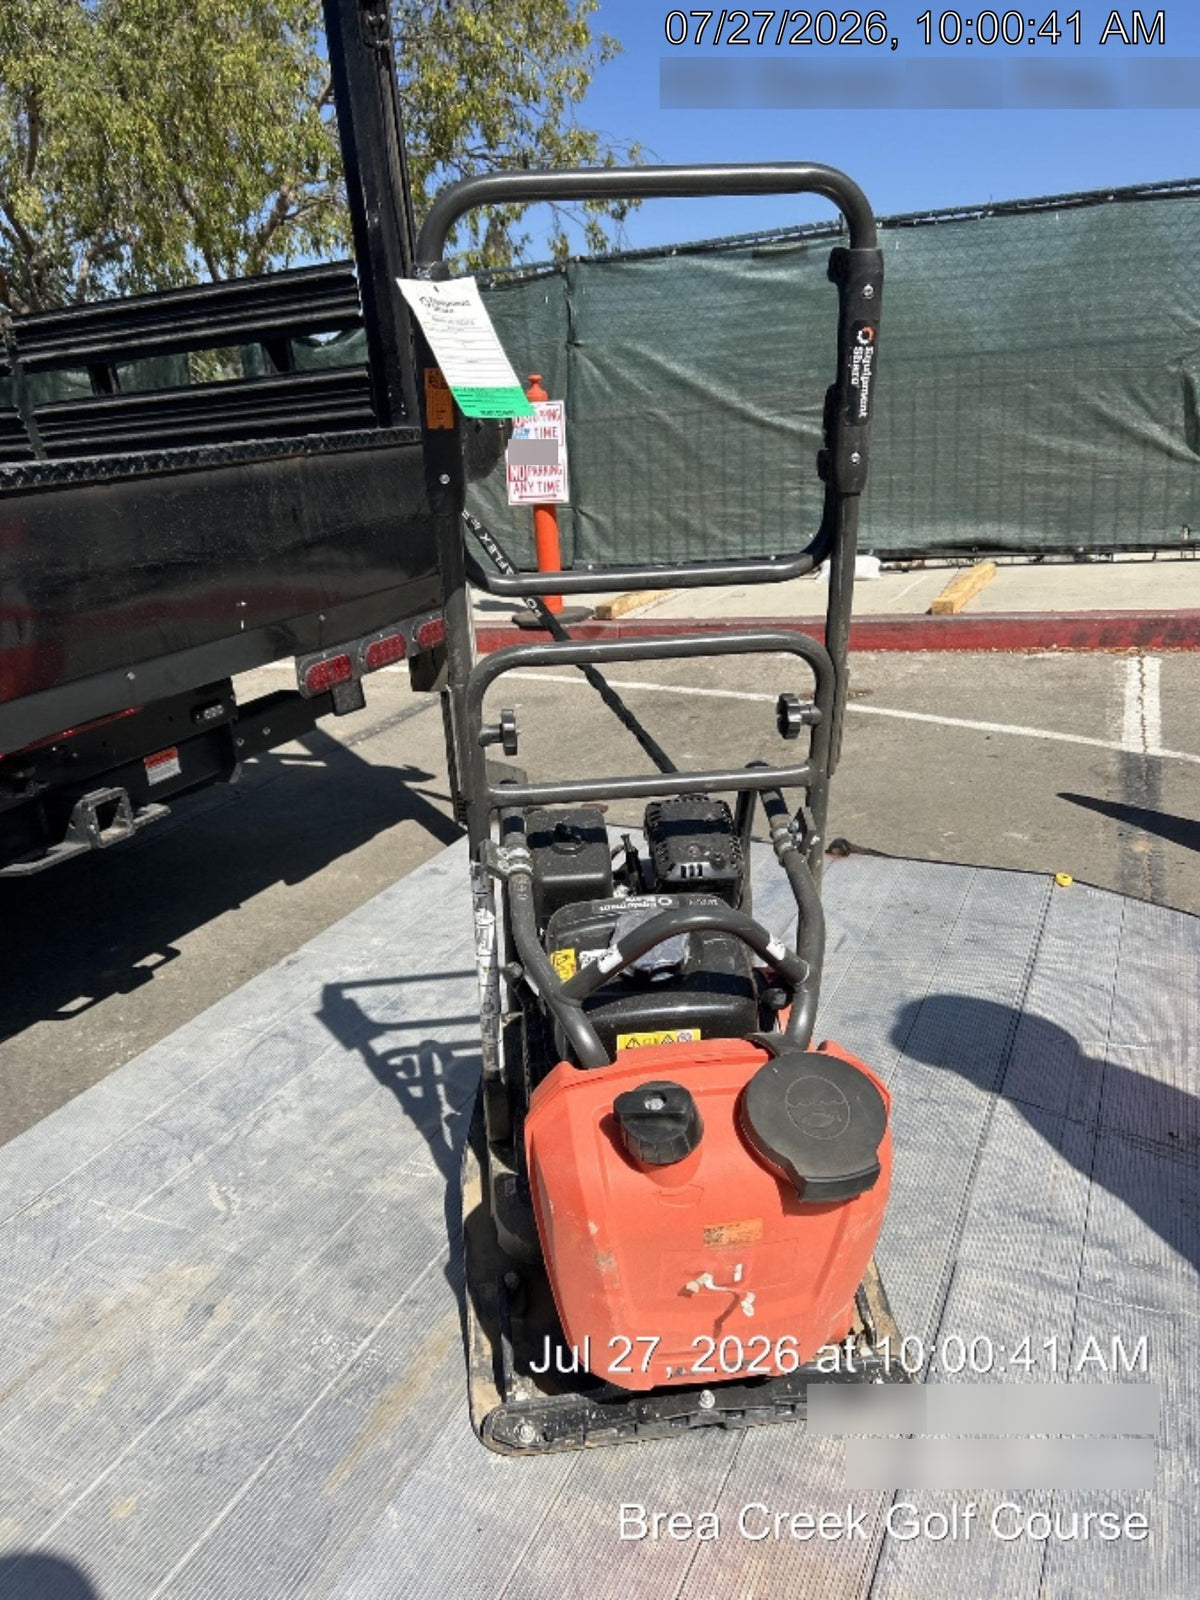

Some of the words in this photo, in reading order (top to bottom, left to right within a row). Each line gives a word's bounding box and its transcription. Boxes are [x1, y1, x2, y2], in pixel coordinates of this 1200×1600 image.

[508, 464, 527, 481] NO
[514, 481, 534, 494] ANY
[536, 480, 562, 494] TIME
